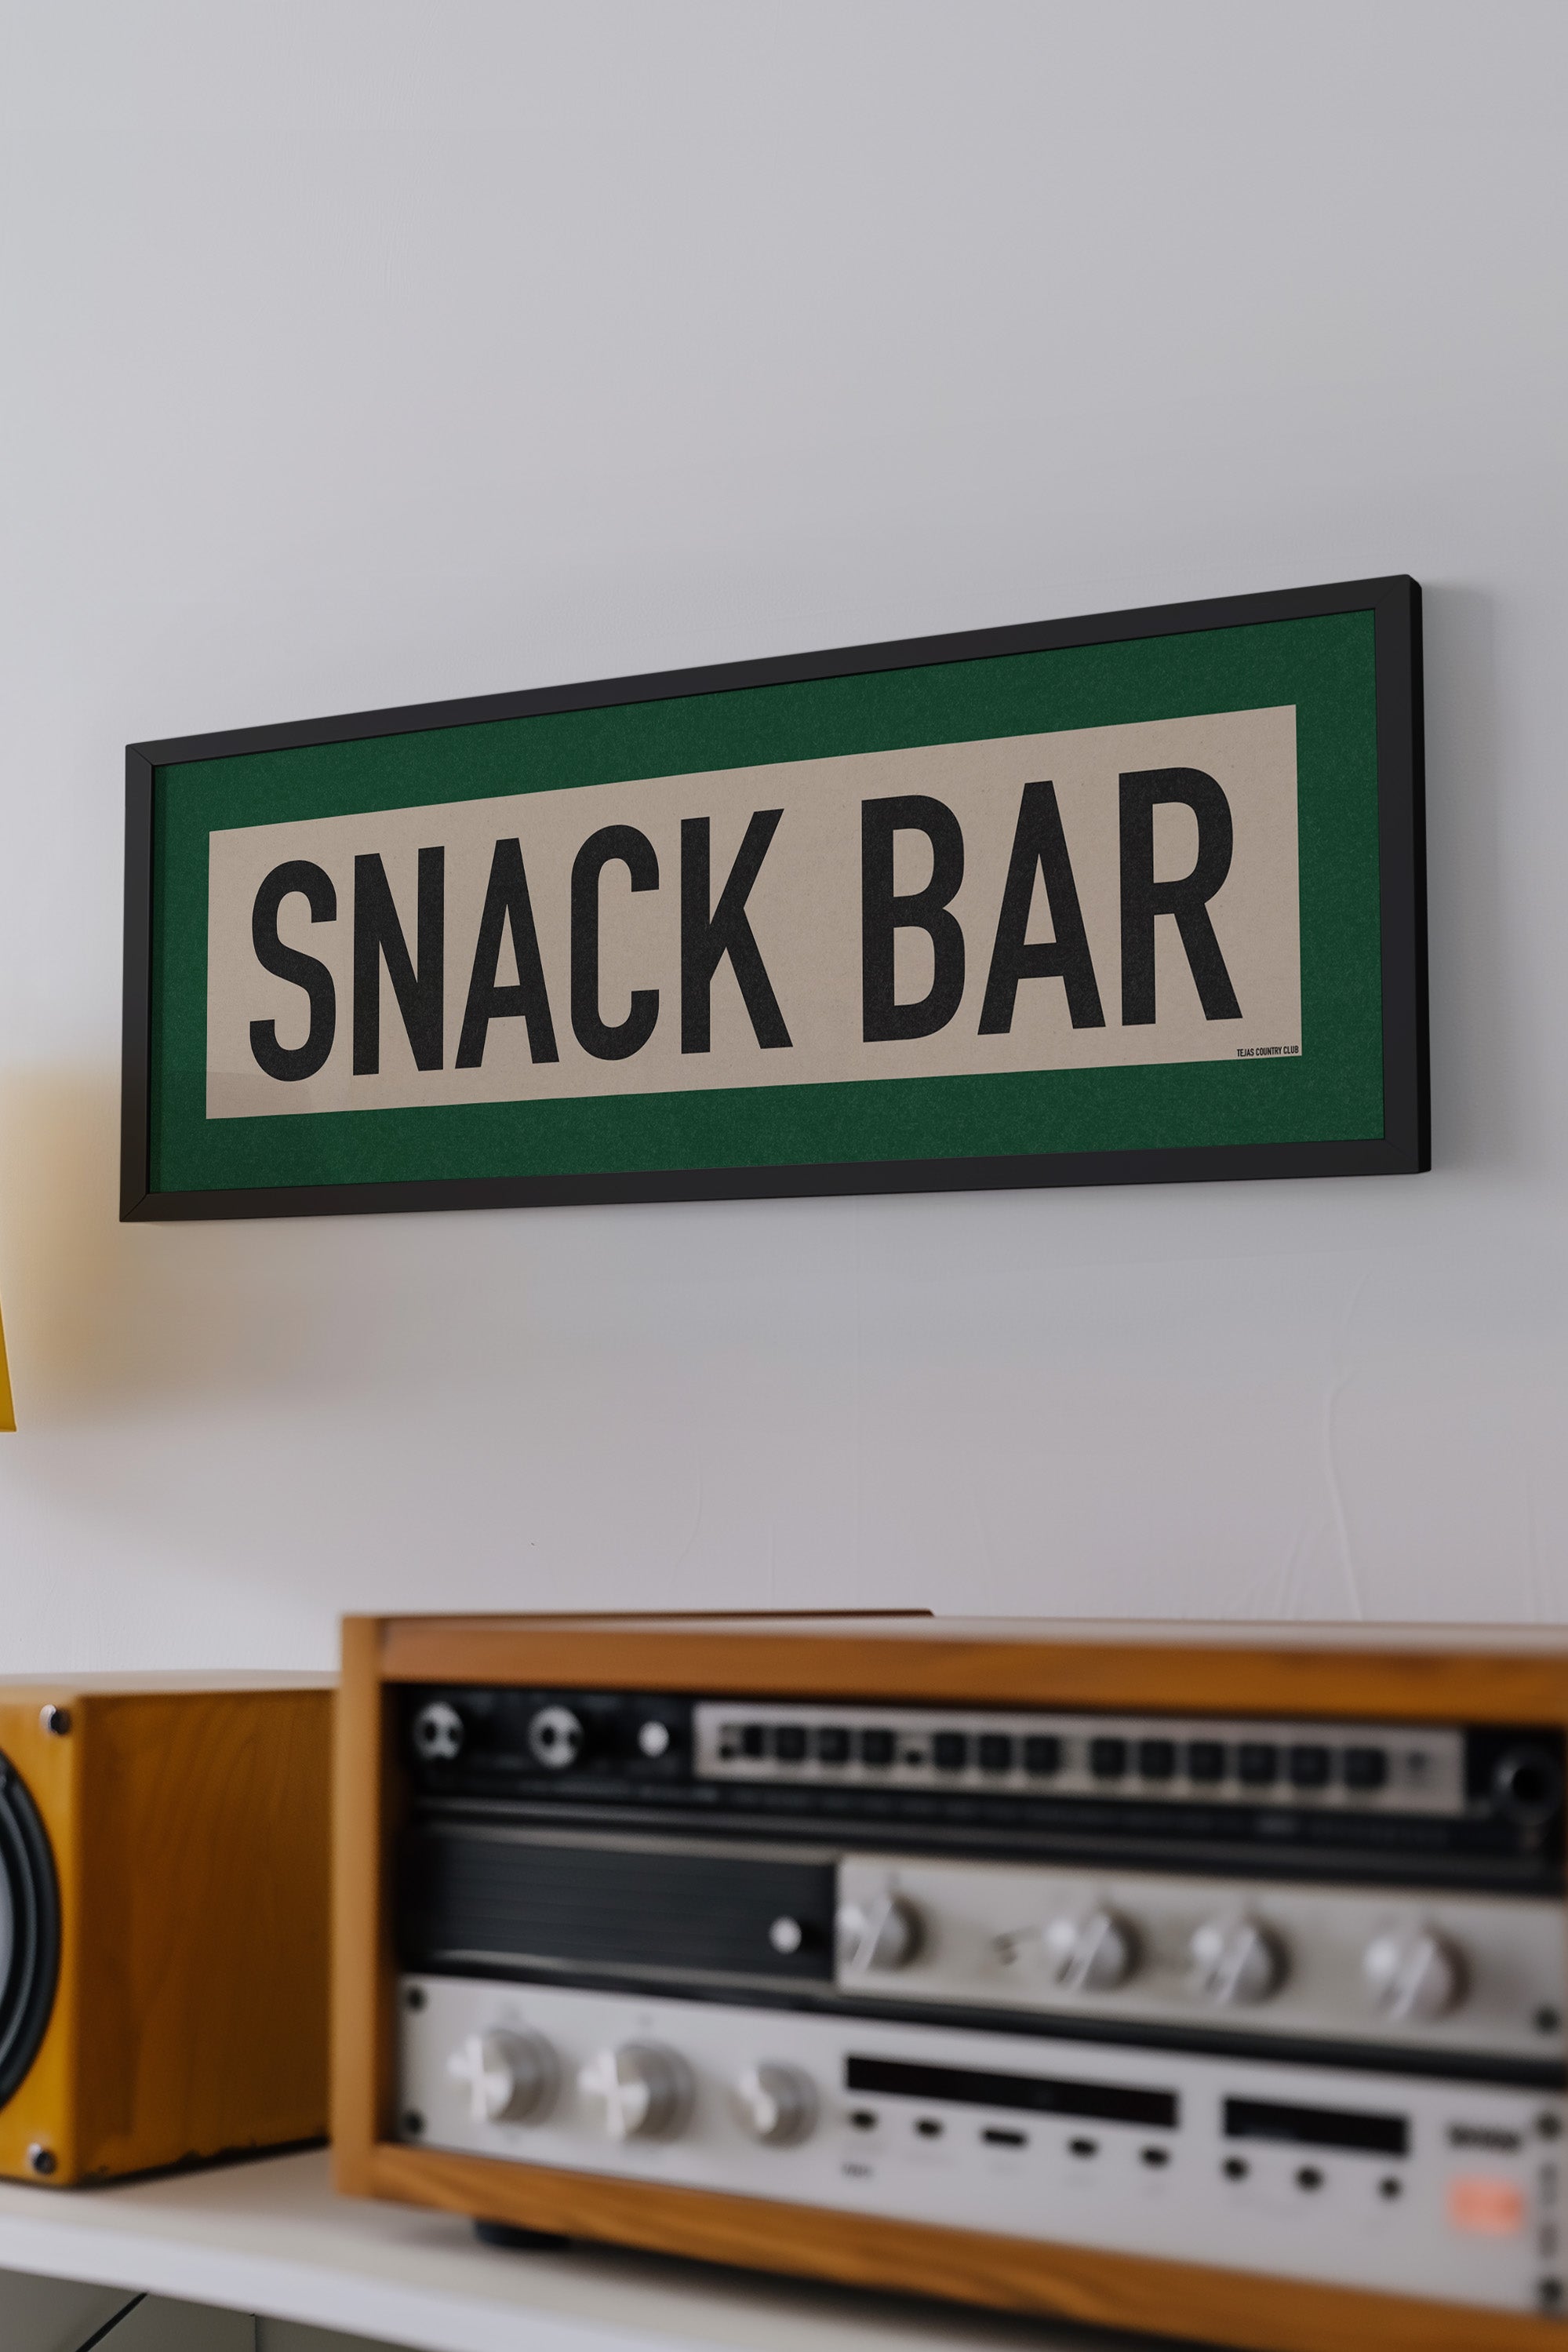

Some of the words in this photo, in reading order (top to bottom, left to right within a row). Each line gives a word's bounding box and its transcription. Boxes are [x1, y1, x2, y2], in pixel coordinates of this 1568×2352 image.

[250, 809, 793, 1081] SNACK
[862, 767, 1242, 1043] BAR
[1236, 1048, 1255, 1057] TEJAS
[1256, 1047, 1282, 1056] COUNTRY
[1283, 1046, 1299, 1054] CLUB
